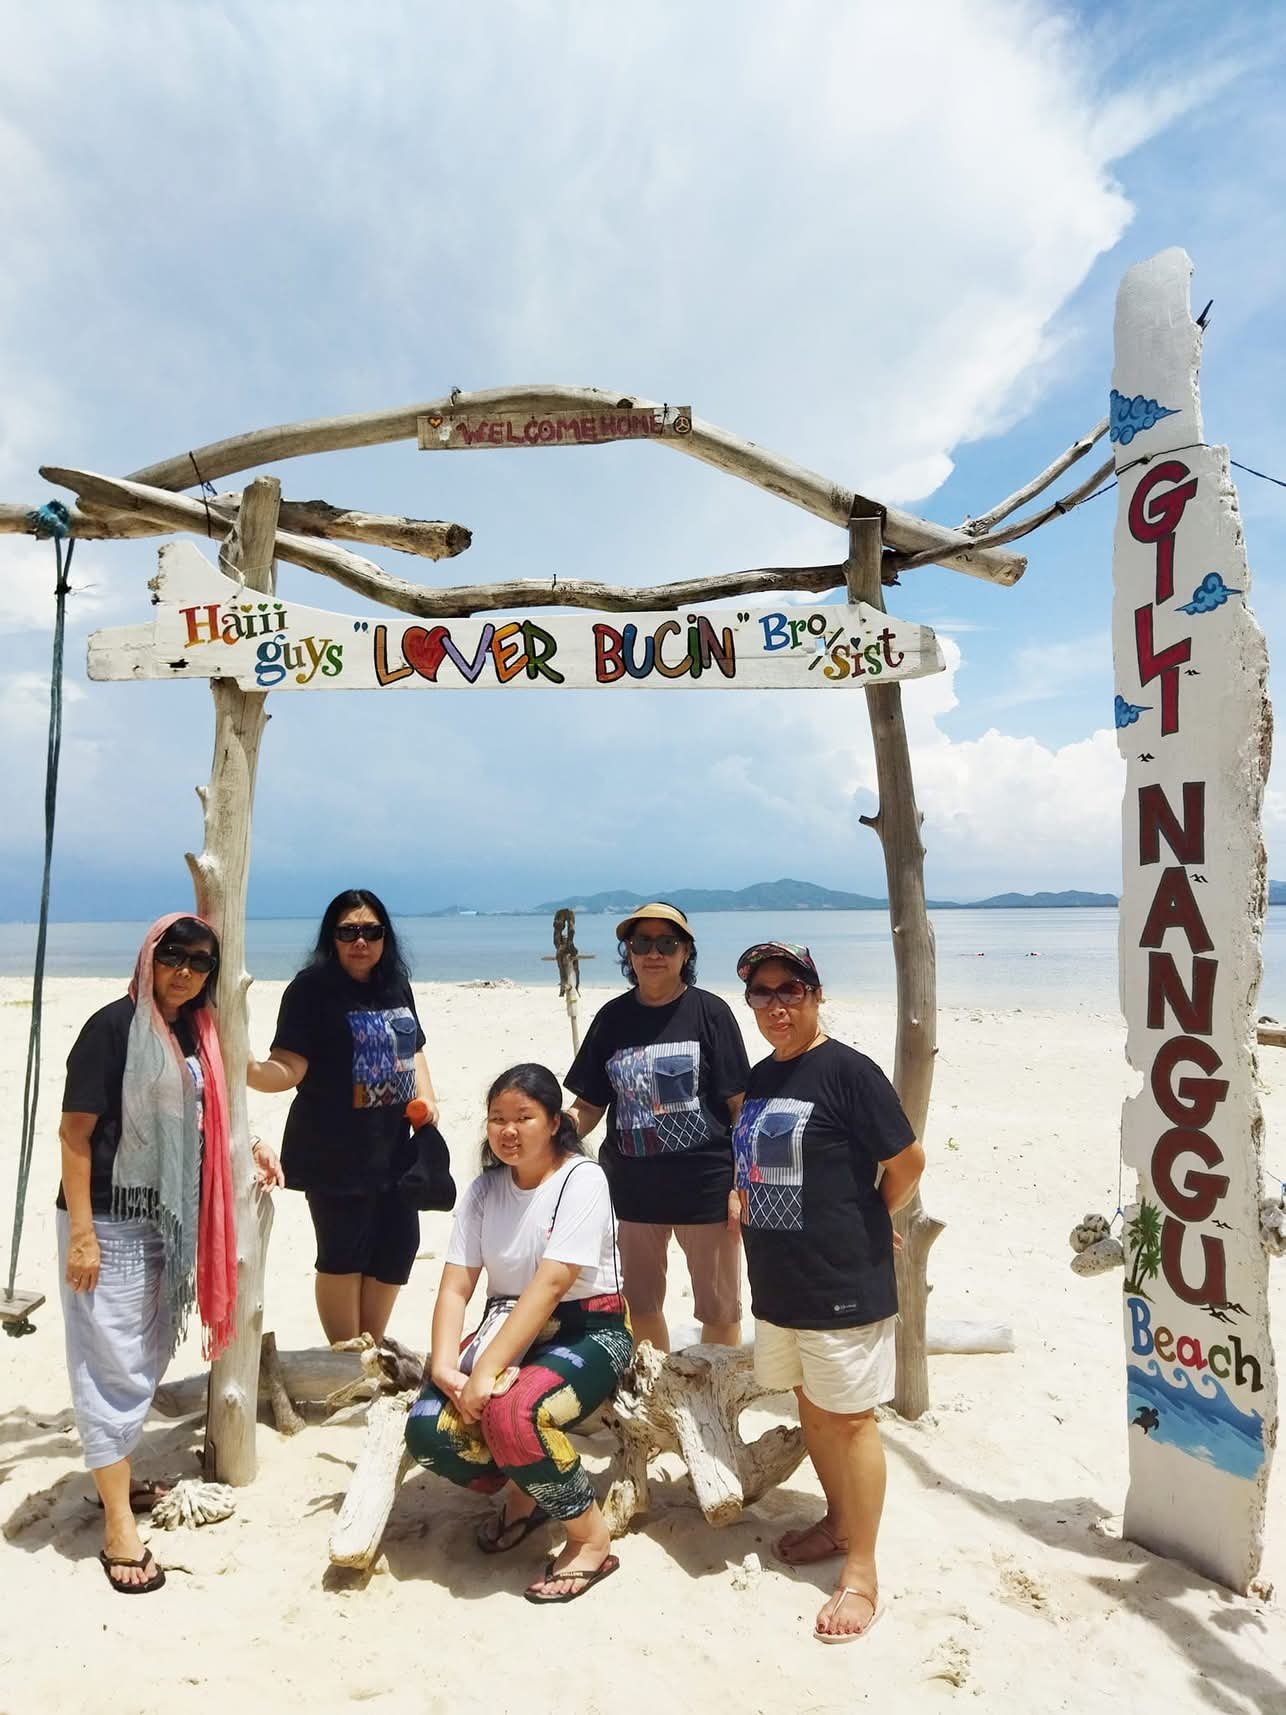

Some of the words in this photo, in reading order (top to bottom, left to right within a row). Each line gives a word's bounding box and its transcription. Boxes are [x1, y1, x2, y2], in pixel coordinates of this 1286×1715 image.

[455, 418, 596, 445] WELCOME
[601, 414, 665, 435] HOME
[254, 634, 343, 687] guys
[1138, 781, 1231, 1309] NANGGU
[1127, 1297, 1264, 1393] Beach
